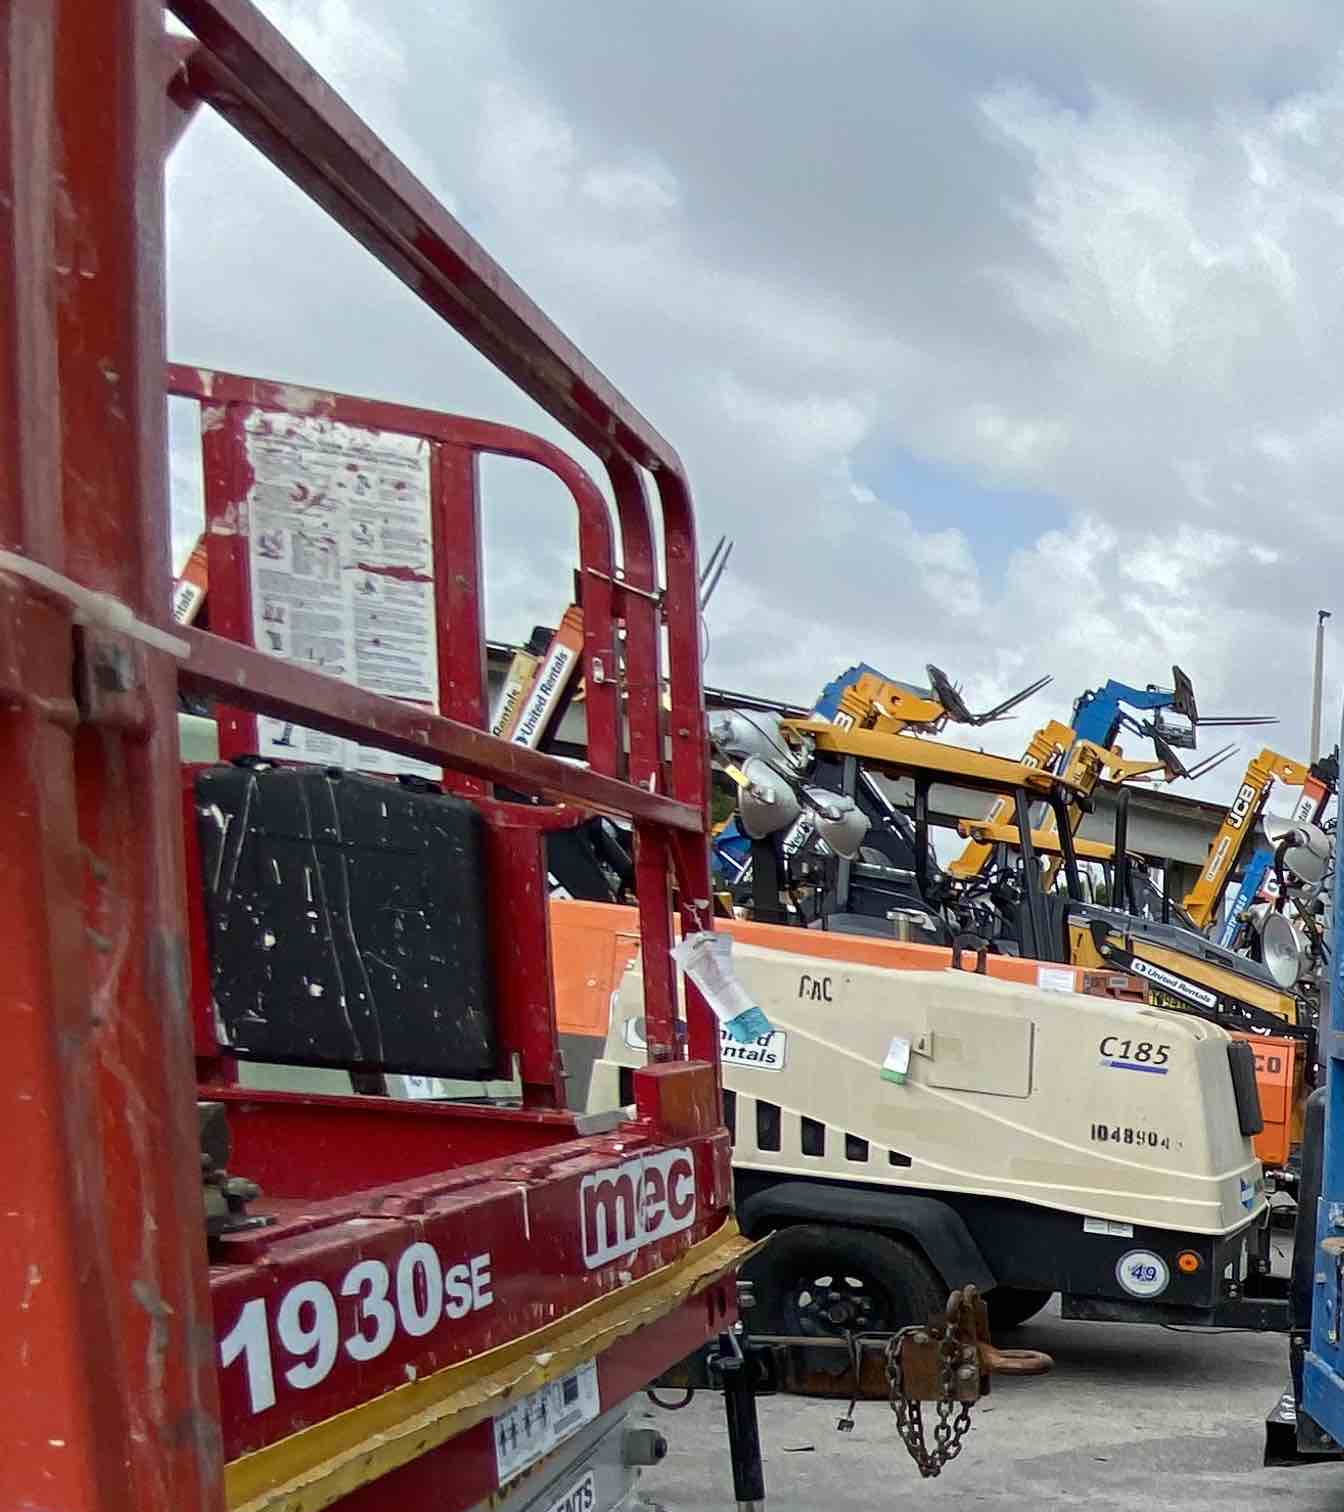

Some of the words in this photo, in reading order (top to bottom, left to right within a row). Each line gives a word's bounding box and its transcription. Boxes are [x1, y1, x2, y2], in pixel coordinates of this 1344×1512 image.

[492, 688, 520, 737] Rentals
[522, 693, 547, 737] United
[540, 649, 568, 697] Rentals
[1226, 783, 1257, 829] JCB
[1147, 965, 1178, 989] United
[1178, 983, 1211, 1004] Rentals
[1099, 1036, 1170, 1065] C185
